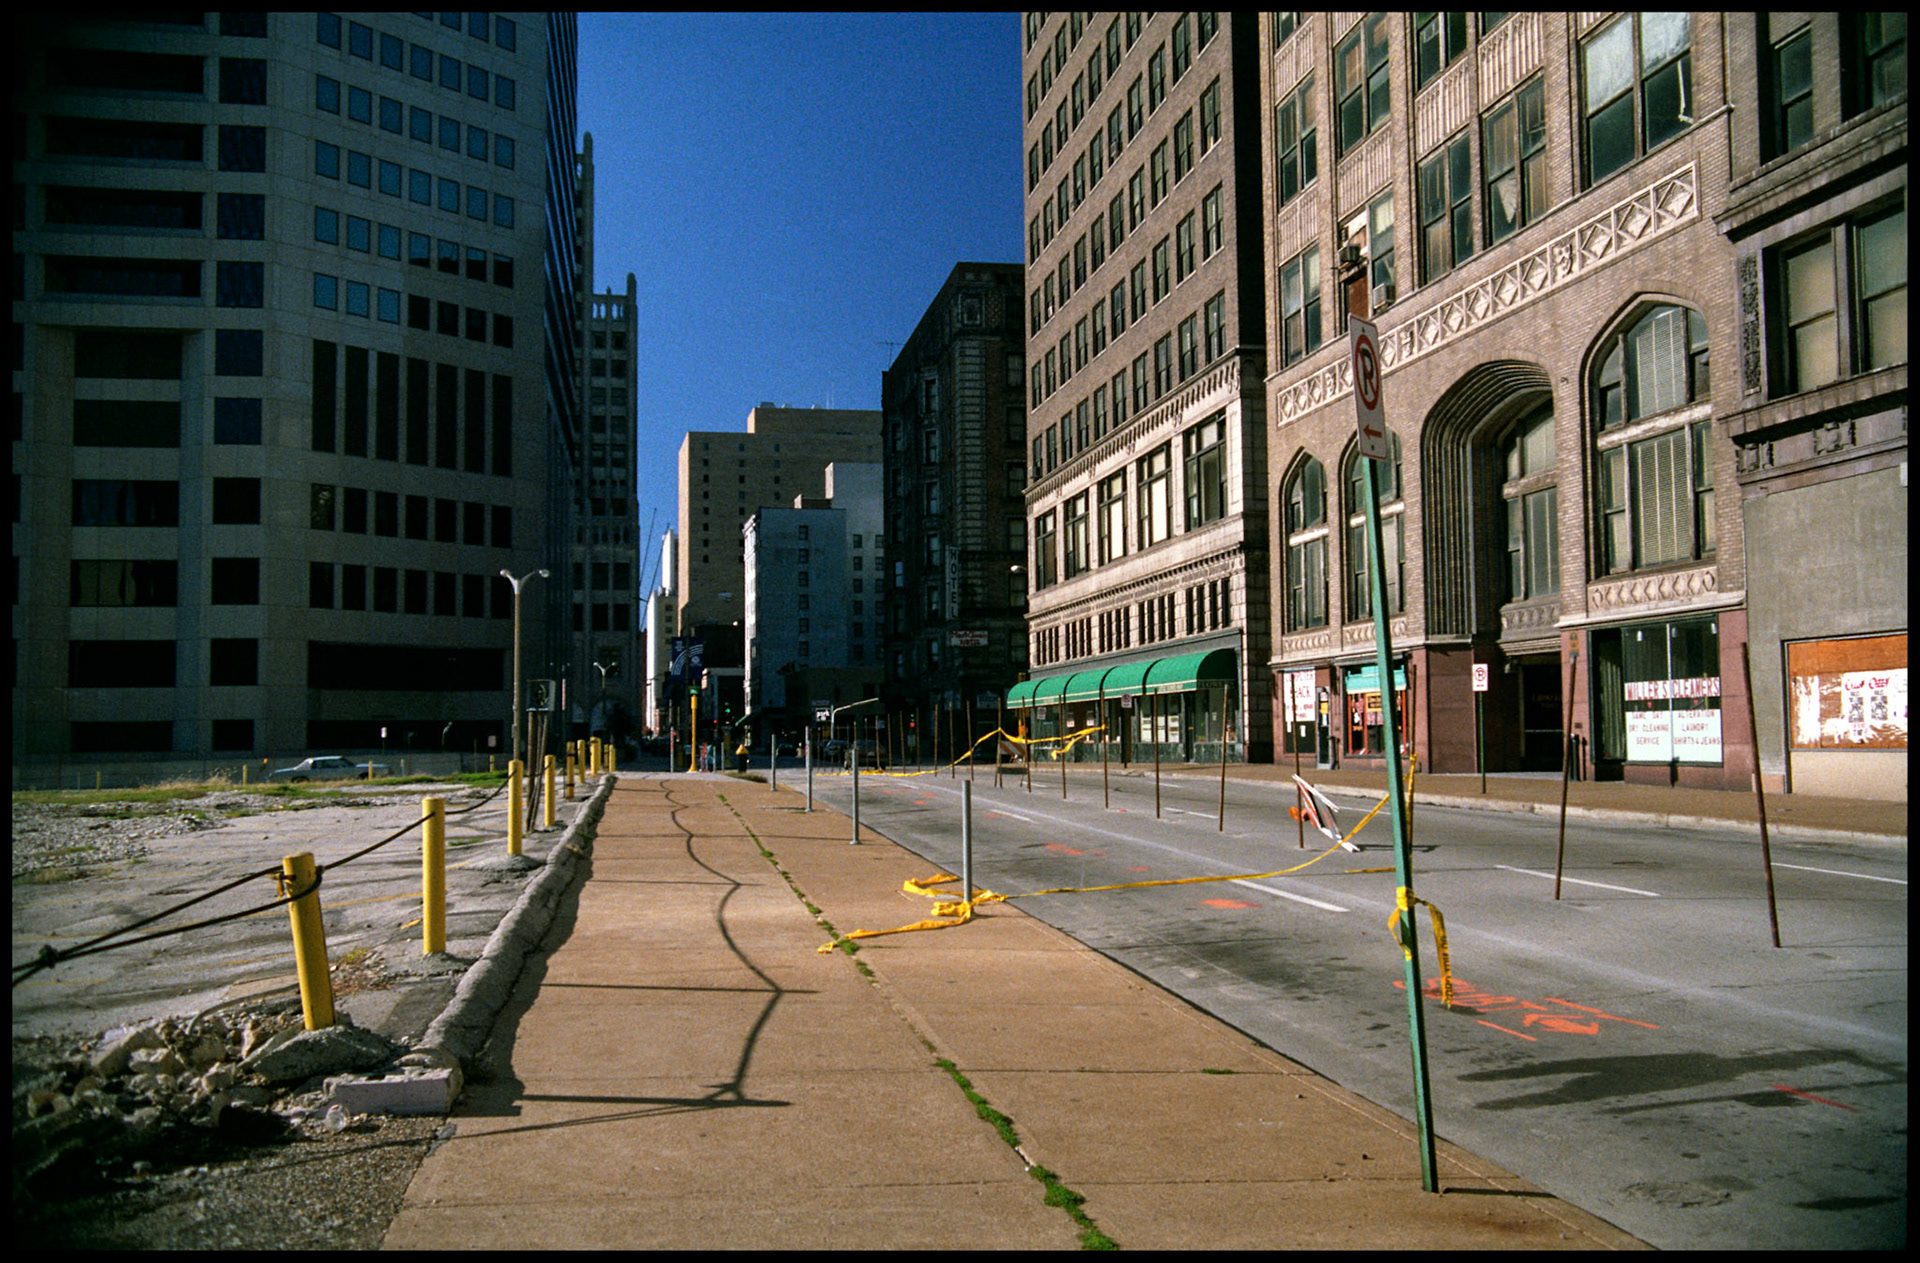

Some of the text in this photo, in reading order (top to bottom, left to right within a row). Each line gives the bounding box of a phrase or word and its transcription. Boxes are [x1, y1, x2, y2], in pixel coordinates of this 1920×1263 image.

[950, 548, 958, 618] HOTEL
[1672, 677, 1720, 698] CLEANERS
[1678, 709, 1715, 719] ALTERATION
[1642, 724, 1669, 733] CLEANING
[1682, 723, 1709, 732] LAUNDRY
[1636, 737, 1660, 745] SERVICE
[1673, 736, 1695, 745] SHIRTS
[1700, 736, 1721, 745] JEANS
